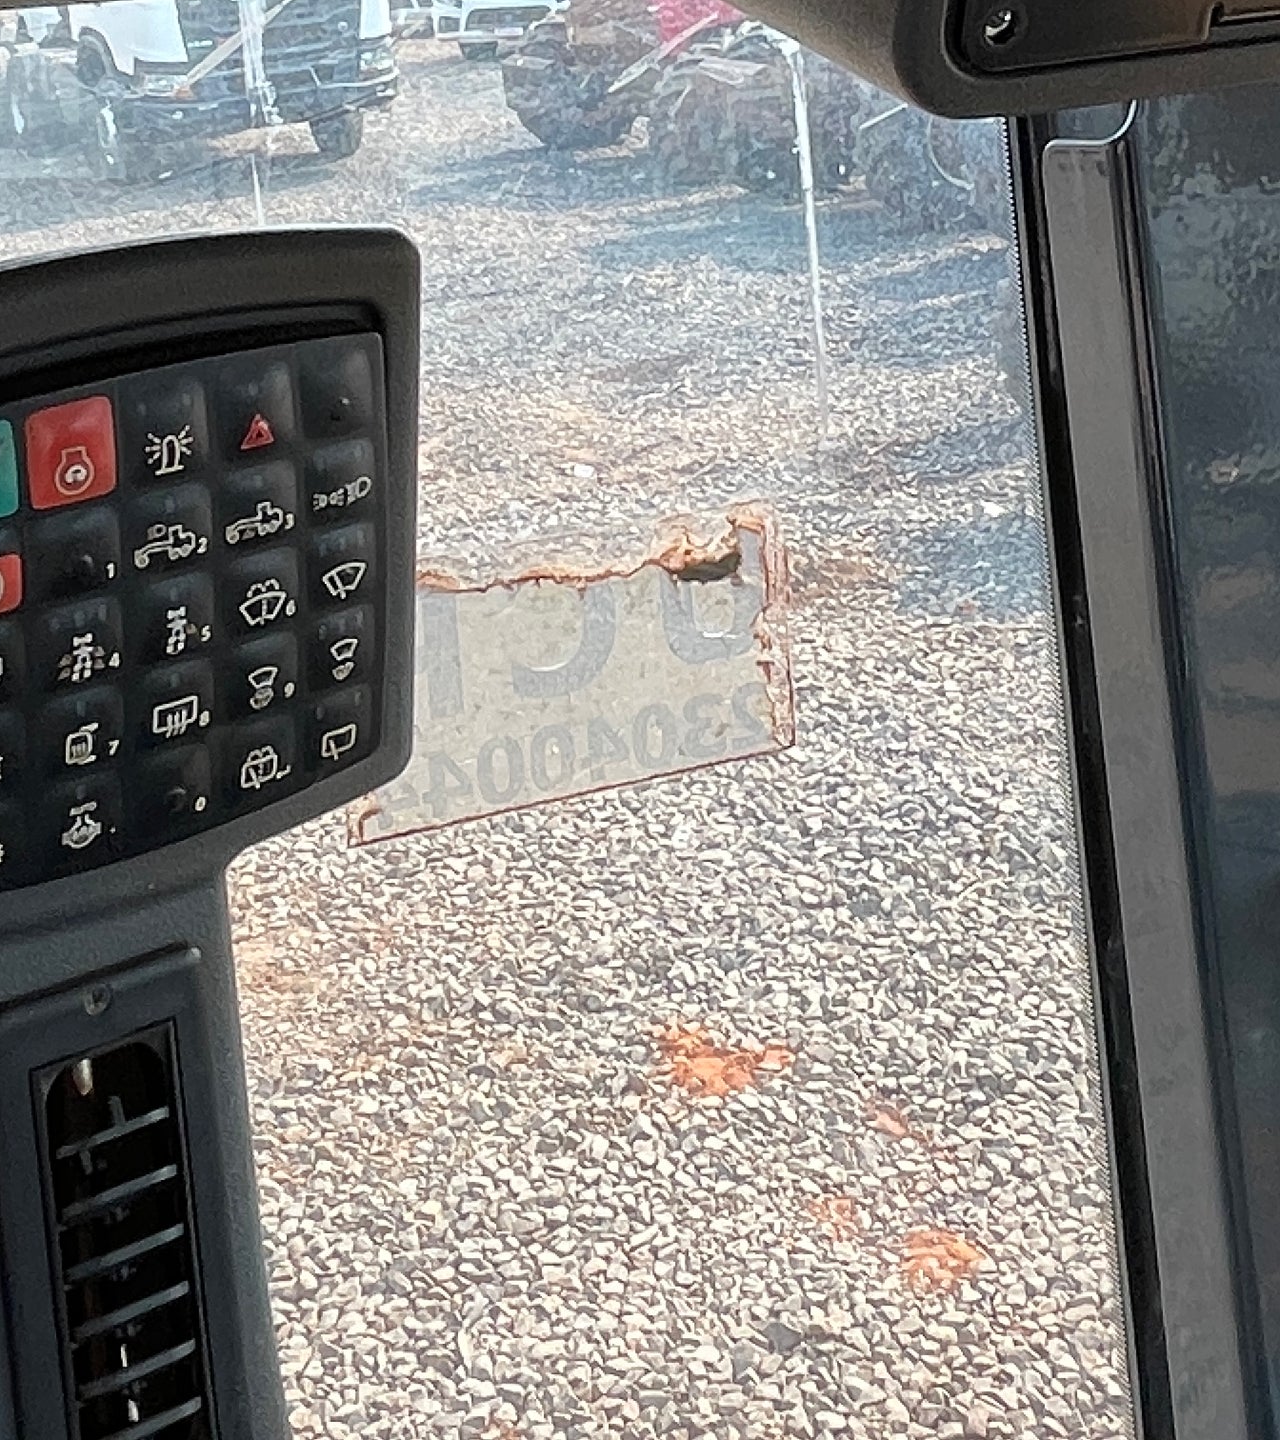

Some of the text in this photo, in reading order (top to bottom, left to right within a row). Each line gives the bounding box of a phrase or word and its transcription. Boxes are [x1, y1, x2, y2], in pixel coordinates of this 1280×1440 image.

[283, 513, 295, 530] 3
[196, 536, 208, 554] 2
[106, 562, 116, 579] 1
[285, 599, 296, 616] 6
[200, 625, 212, 642] 5
[108, 651, 120, 667] 4
[283, 681, 295, 699] 9
[198, 710, 210, 727] 8
[107, 739, 119, 756] 7
[194, 795, 206, 812] 0
